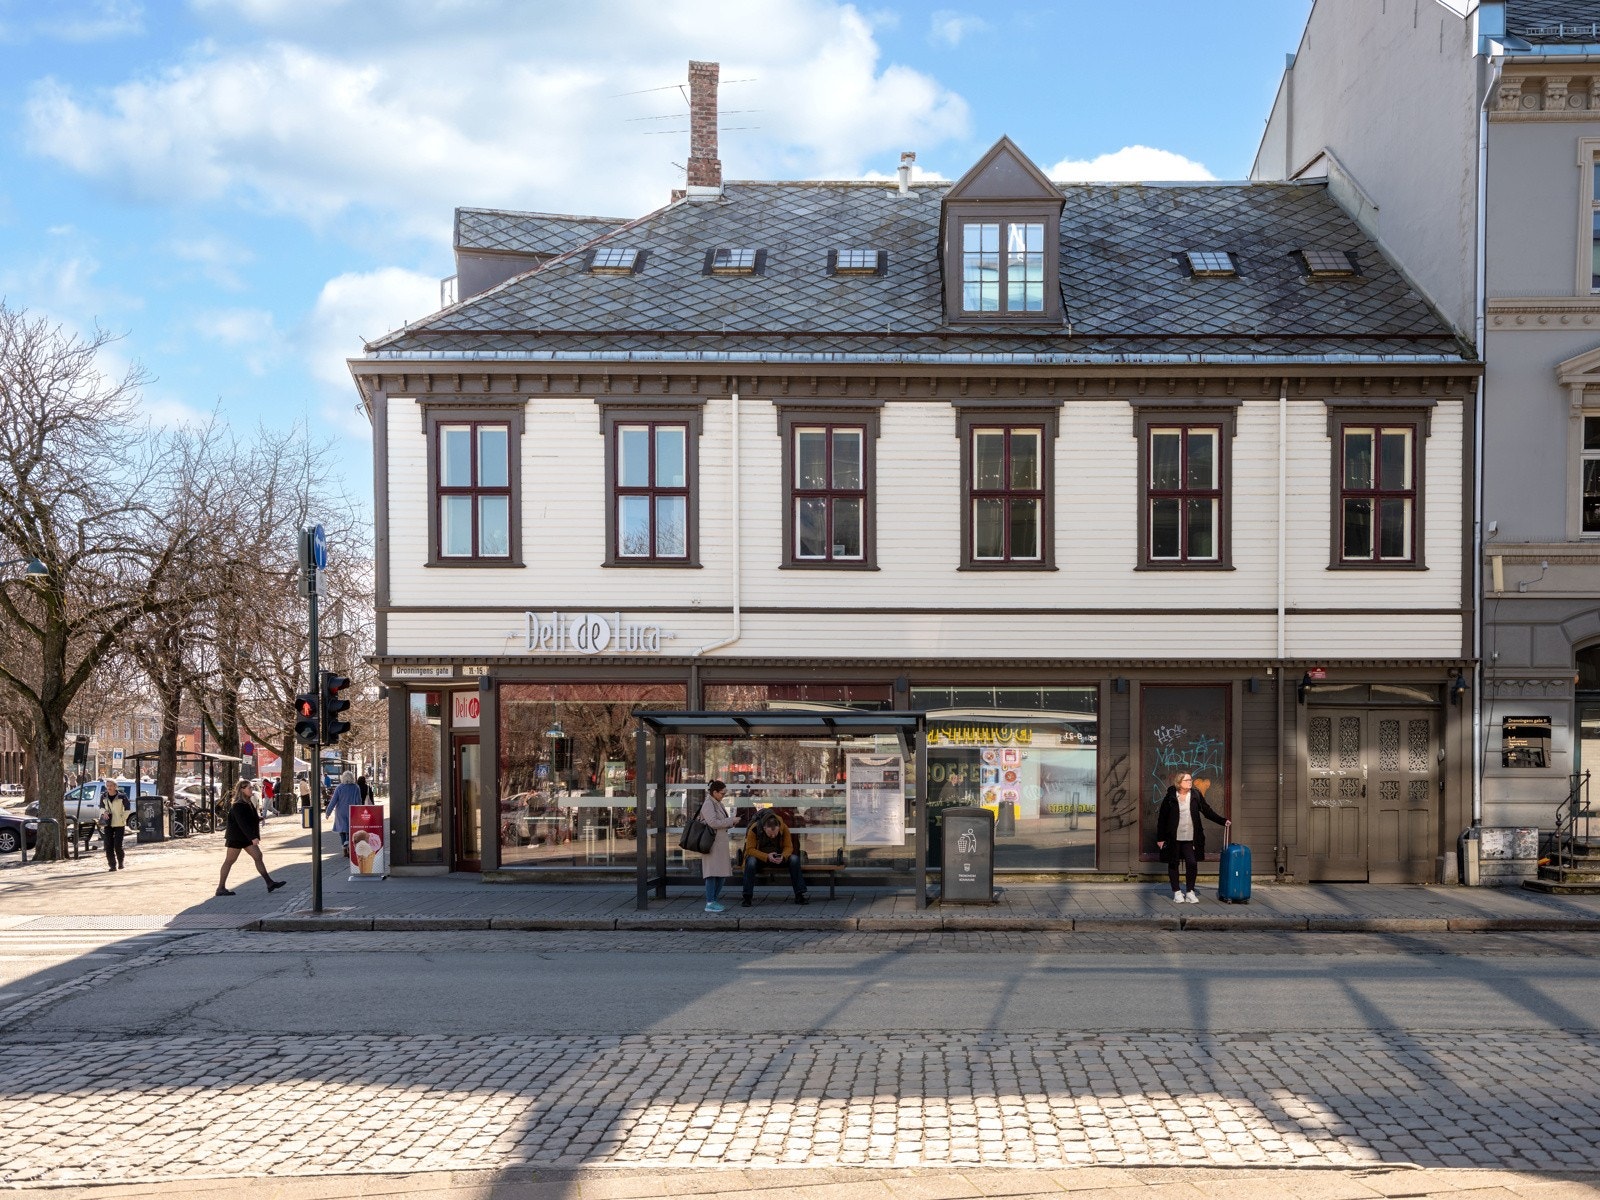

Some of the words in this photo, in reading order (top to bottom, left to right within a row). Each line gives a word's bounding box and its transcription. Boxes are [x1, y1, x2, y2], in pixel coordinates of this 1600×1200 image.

[525, 611, 566, 652] Deli
[575, 613, 604, 652] de
[614, 612, 661, 652] Luca
[396, 666, 434, 676] Dronningens
[435, 666, 449, 676] gate
[455, 697, 468, 718] Deli
